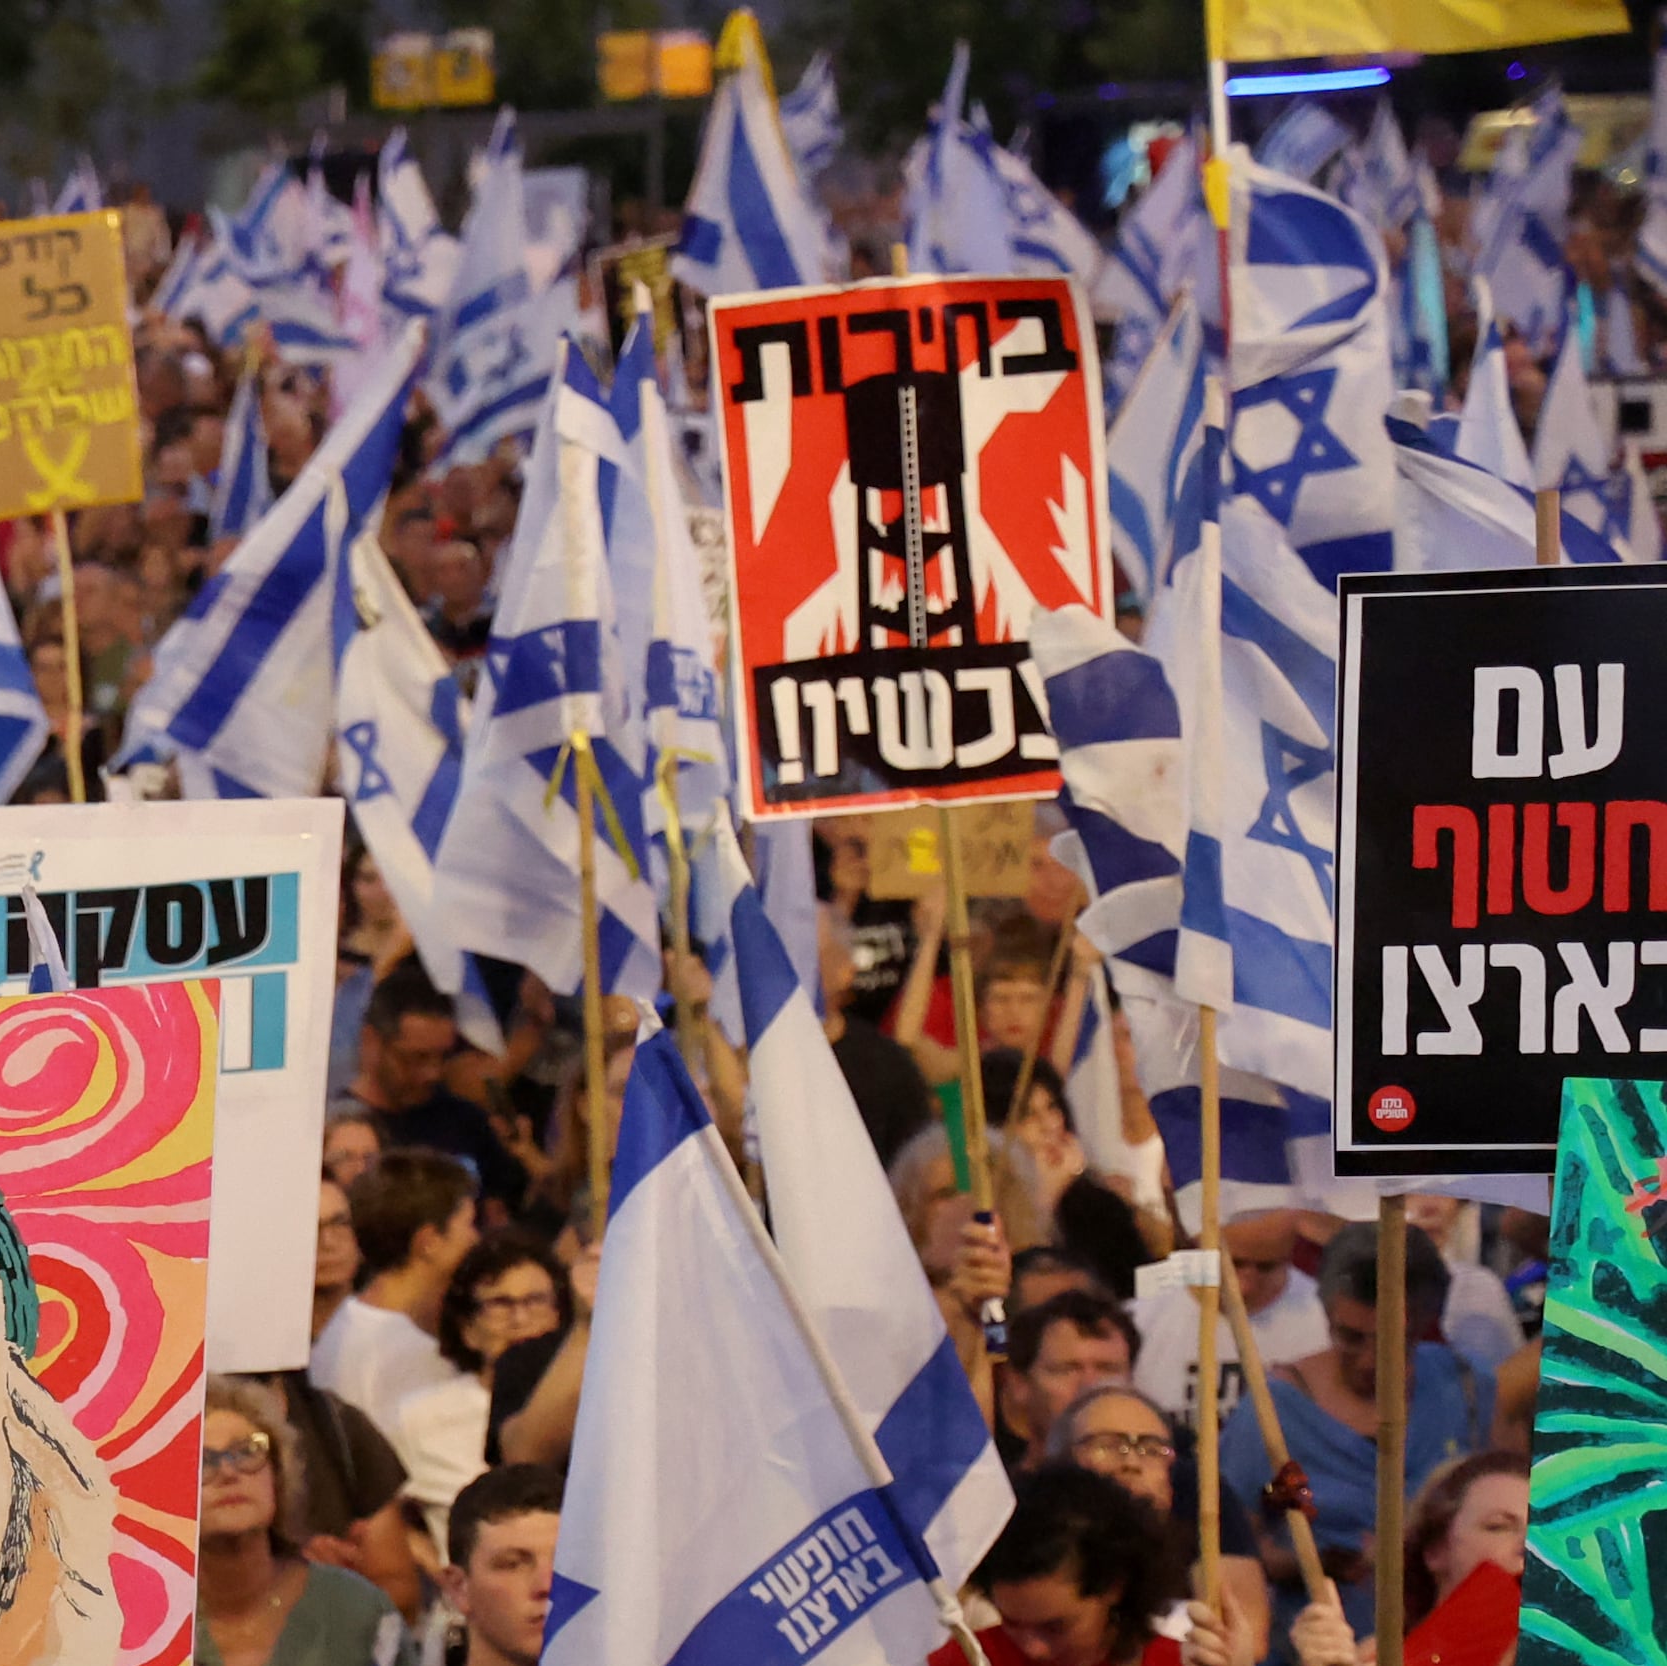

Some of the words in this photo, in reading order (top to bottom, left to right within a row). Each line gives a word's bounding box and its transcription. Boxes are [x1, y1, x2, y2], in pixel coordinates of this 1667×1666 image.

[732, 299, 1078, 402] בחירות
[1471, 663, 1624, 779] עם
[1412, 801, 1667, 928] חטוף
[748, 1505, 876, 1611] חופשי
[775, 1547, 903, 1656] בארצנו
